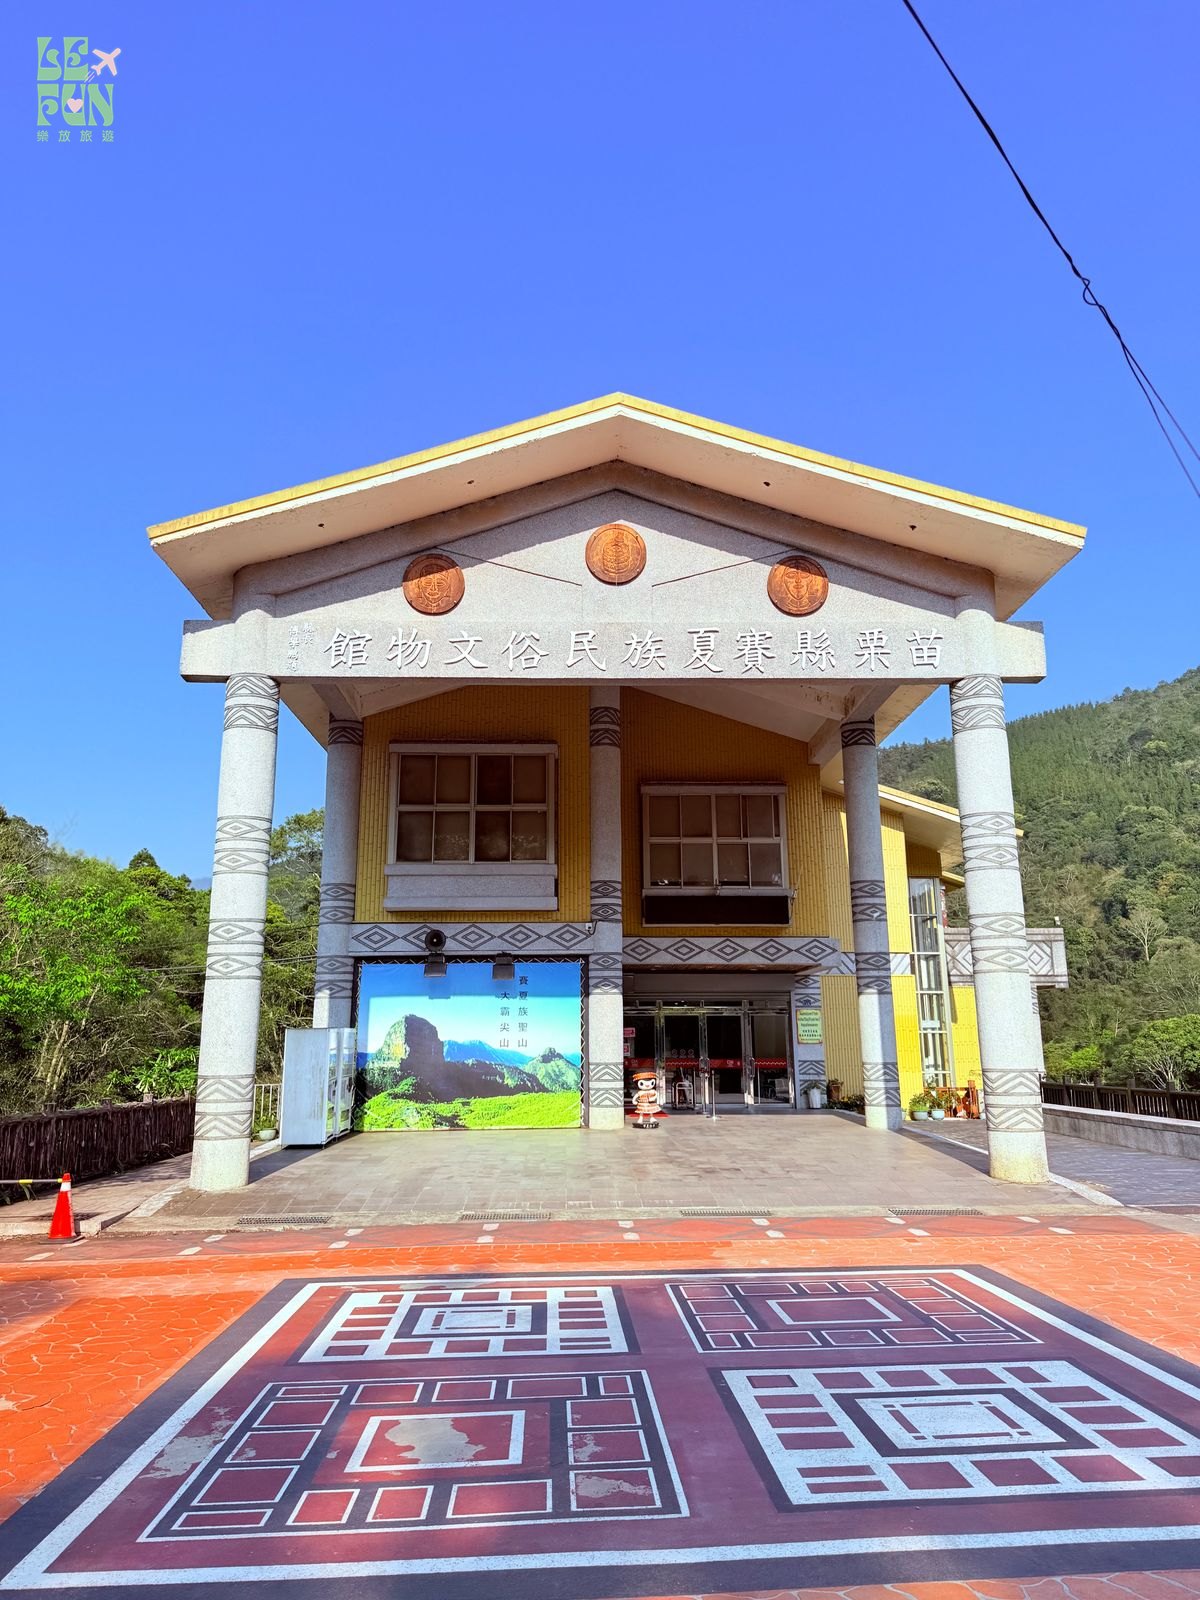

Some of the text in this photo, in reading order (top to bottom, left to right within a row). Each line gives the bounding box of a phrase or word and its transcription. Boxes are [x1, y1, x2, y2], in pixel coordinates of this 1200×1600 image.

[323, 627, 945, 674] 苗栗縣賽夏族民俗文物館
